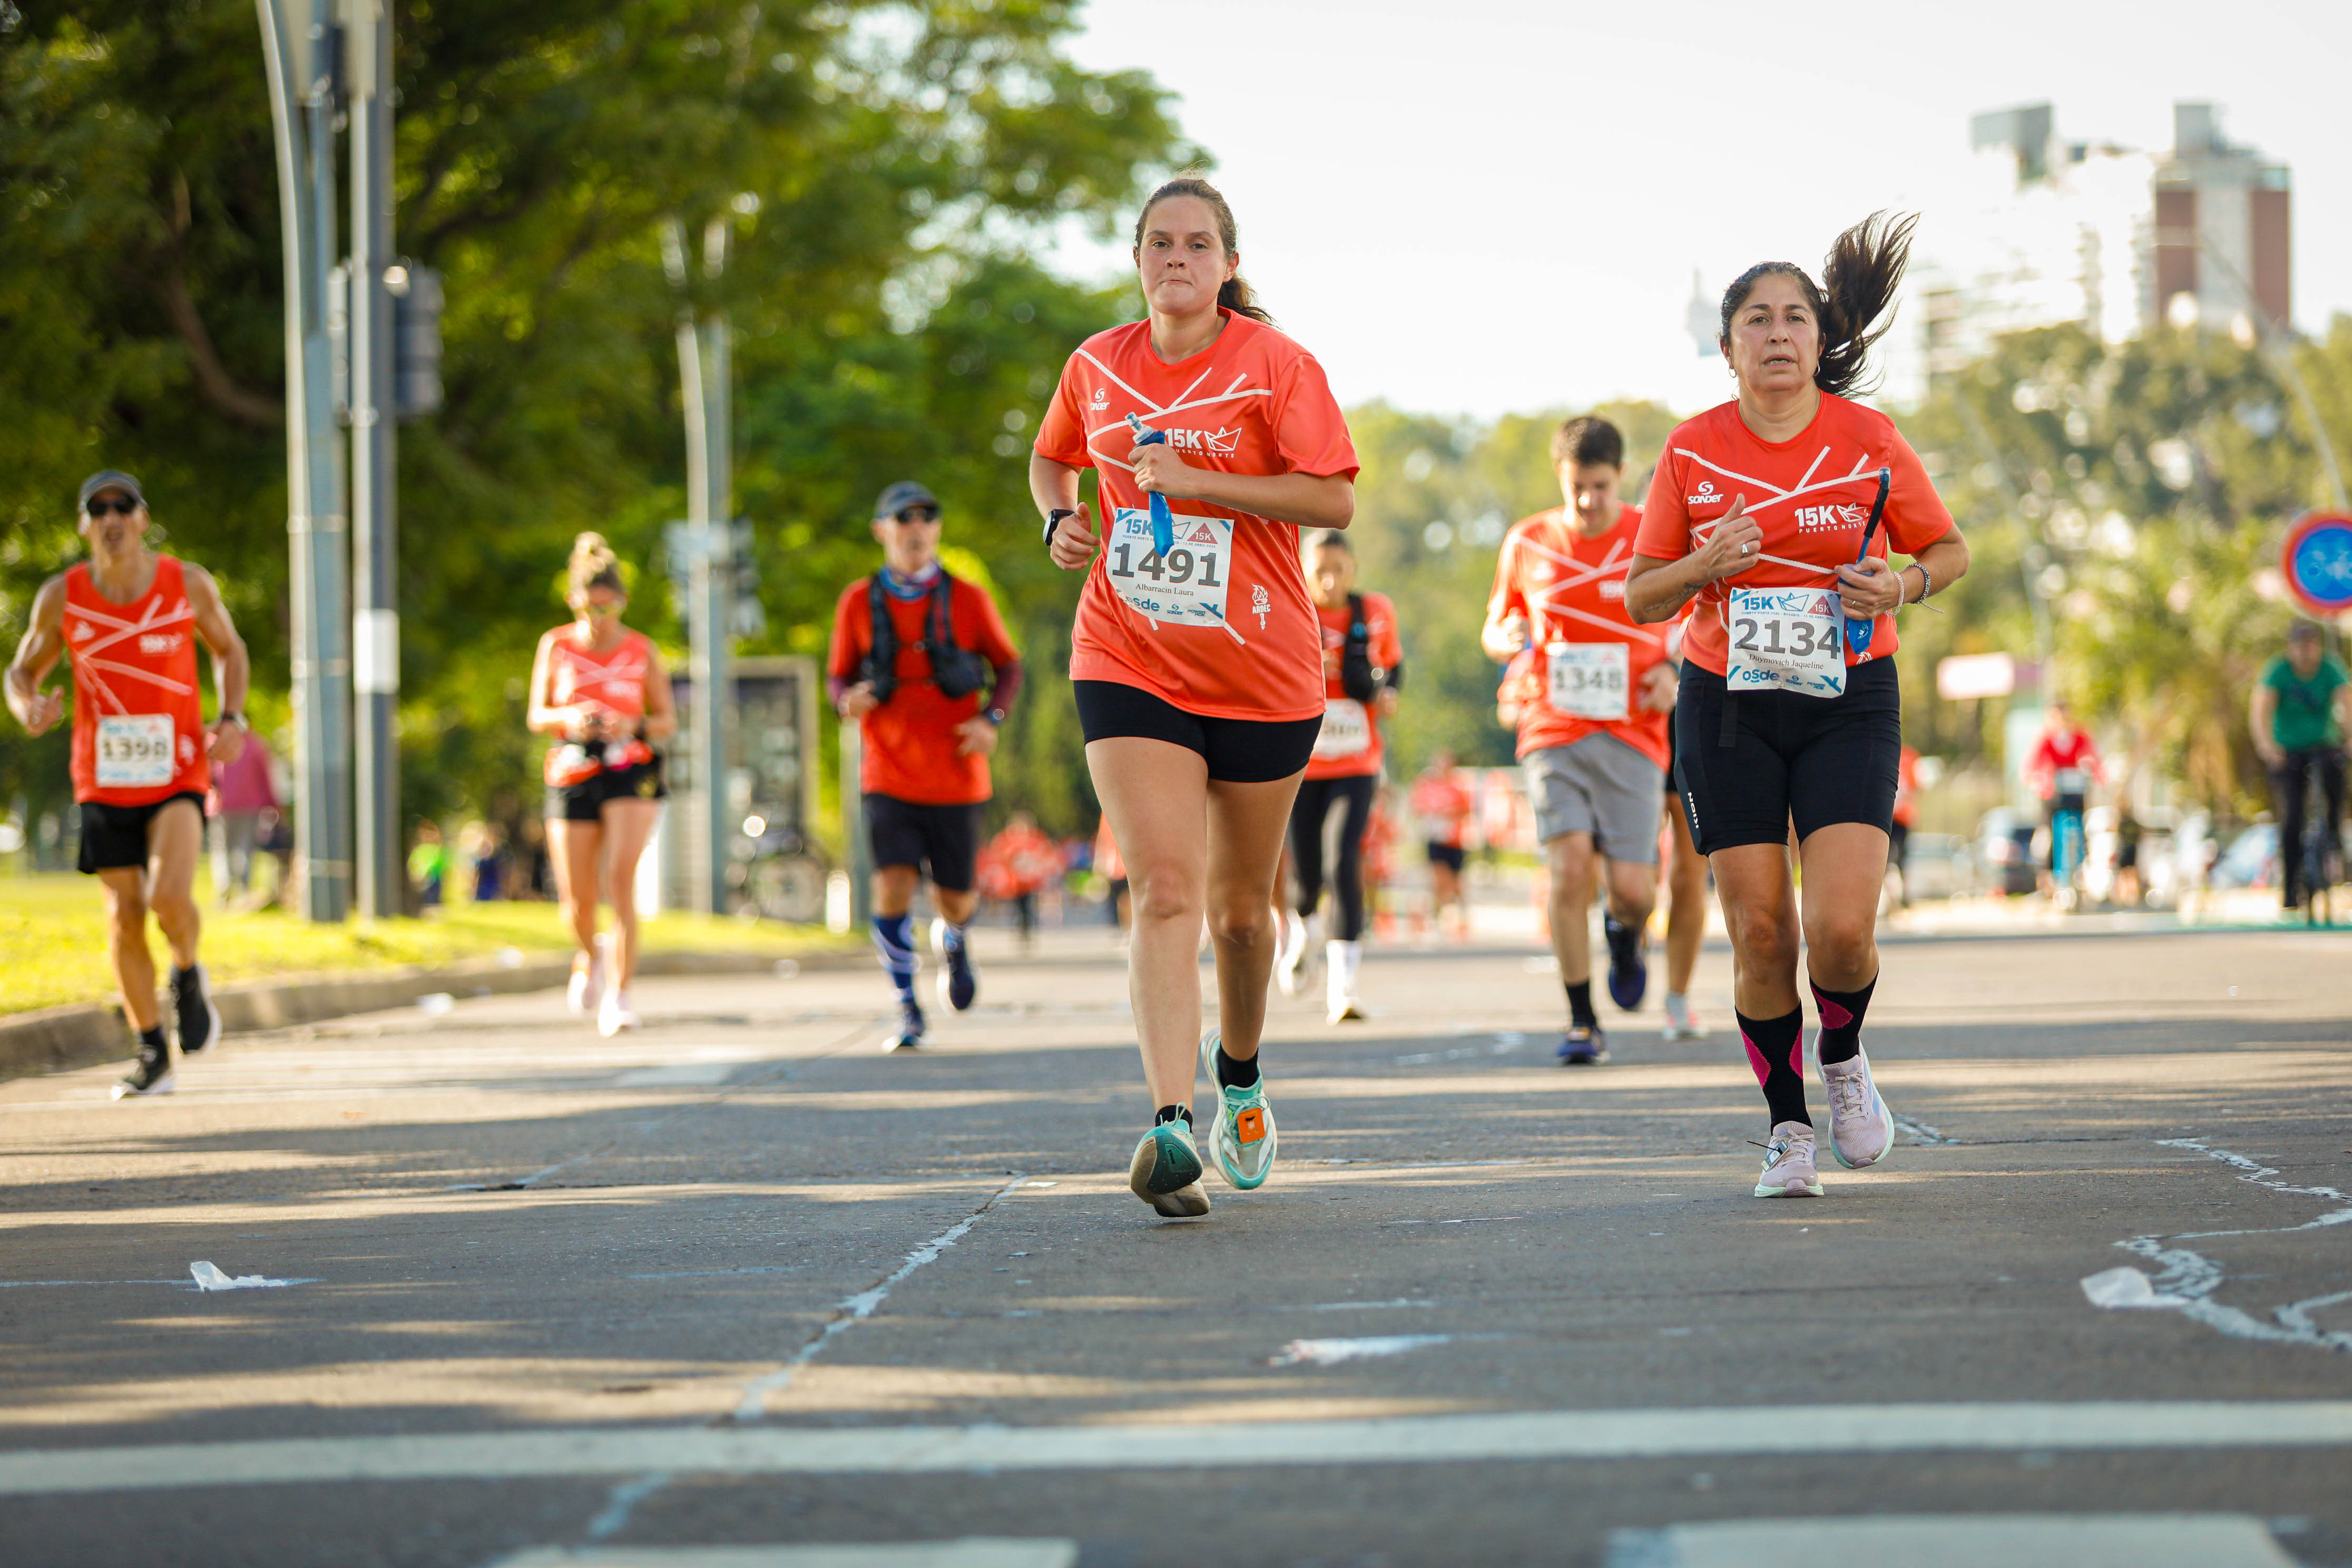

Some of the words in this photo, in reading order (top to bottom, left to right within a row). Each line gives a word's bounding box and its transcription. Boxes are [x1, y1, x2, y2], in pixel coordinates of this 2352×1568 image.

[1164, 428, 1202, 449] 15K
[1794, 505, 1837, 527] 15K
[1125, 518, 1154, 536] 15K
[1799, 525, 1838, 534] PUERTO
[1195, 532, 1211, 541] 15K
[1112, 543, 1220, 587] 1491
[1174, 587, 1194, 596] Laura
[1125, 596, 1160, 612] osde
[1252, 604, 1271, 614] ARDEC
[1742, 596, 1775, 610] 15K
[1814, 604, 1830, 613] 15K
[1734, 618, 1841, 660] 2134
[1749, 654, 1789, 667] Duymovich
[1791, 660, 1824, 670] Jaqueline
[1742, 669, 1780, 681] osde
